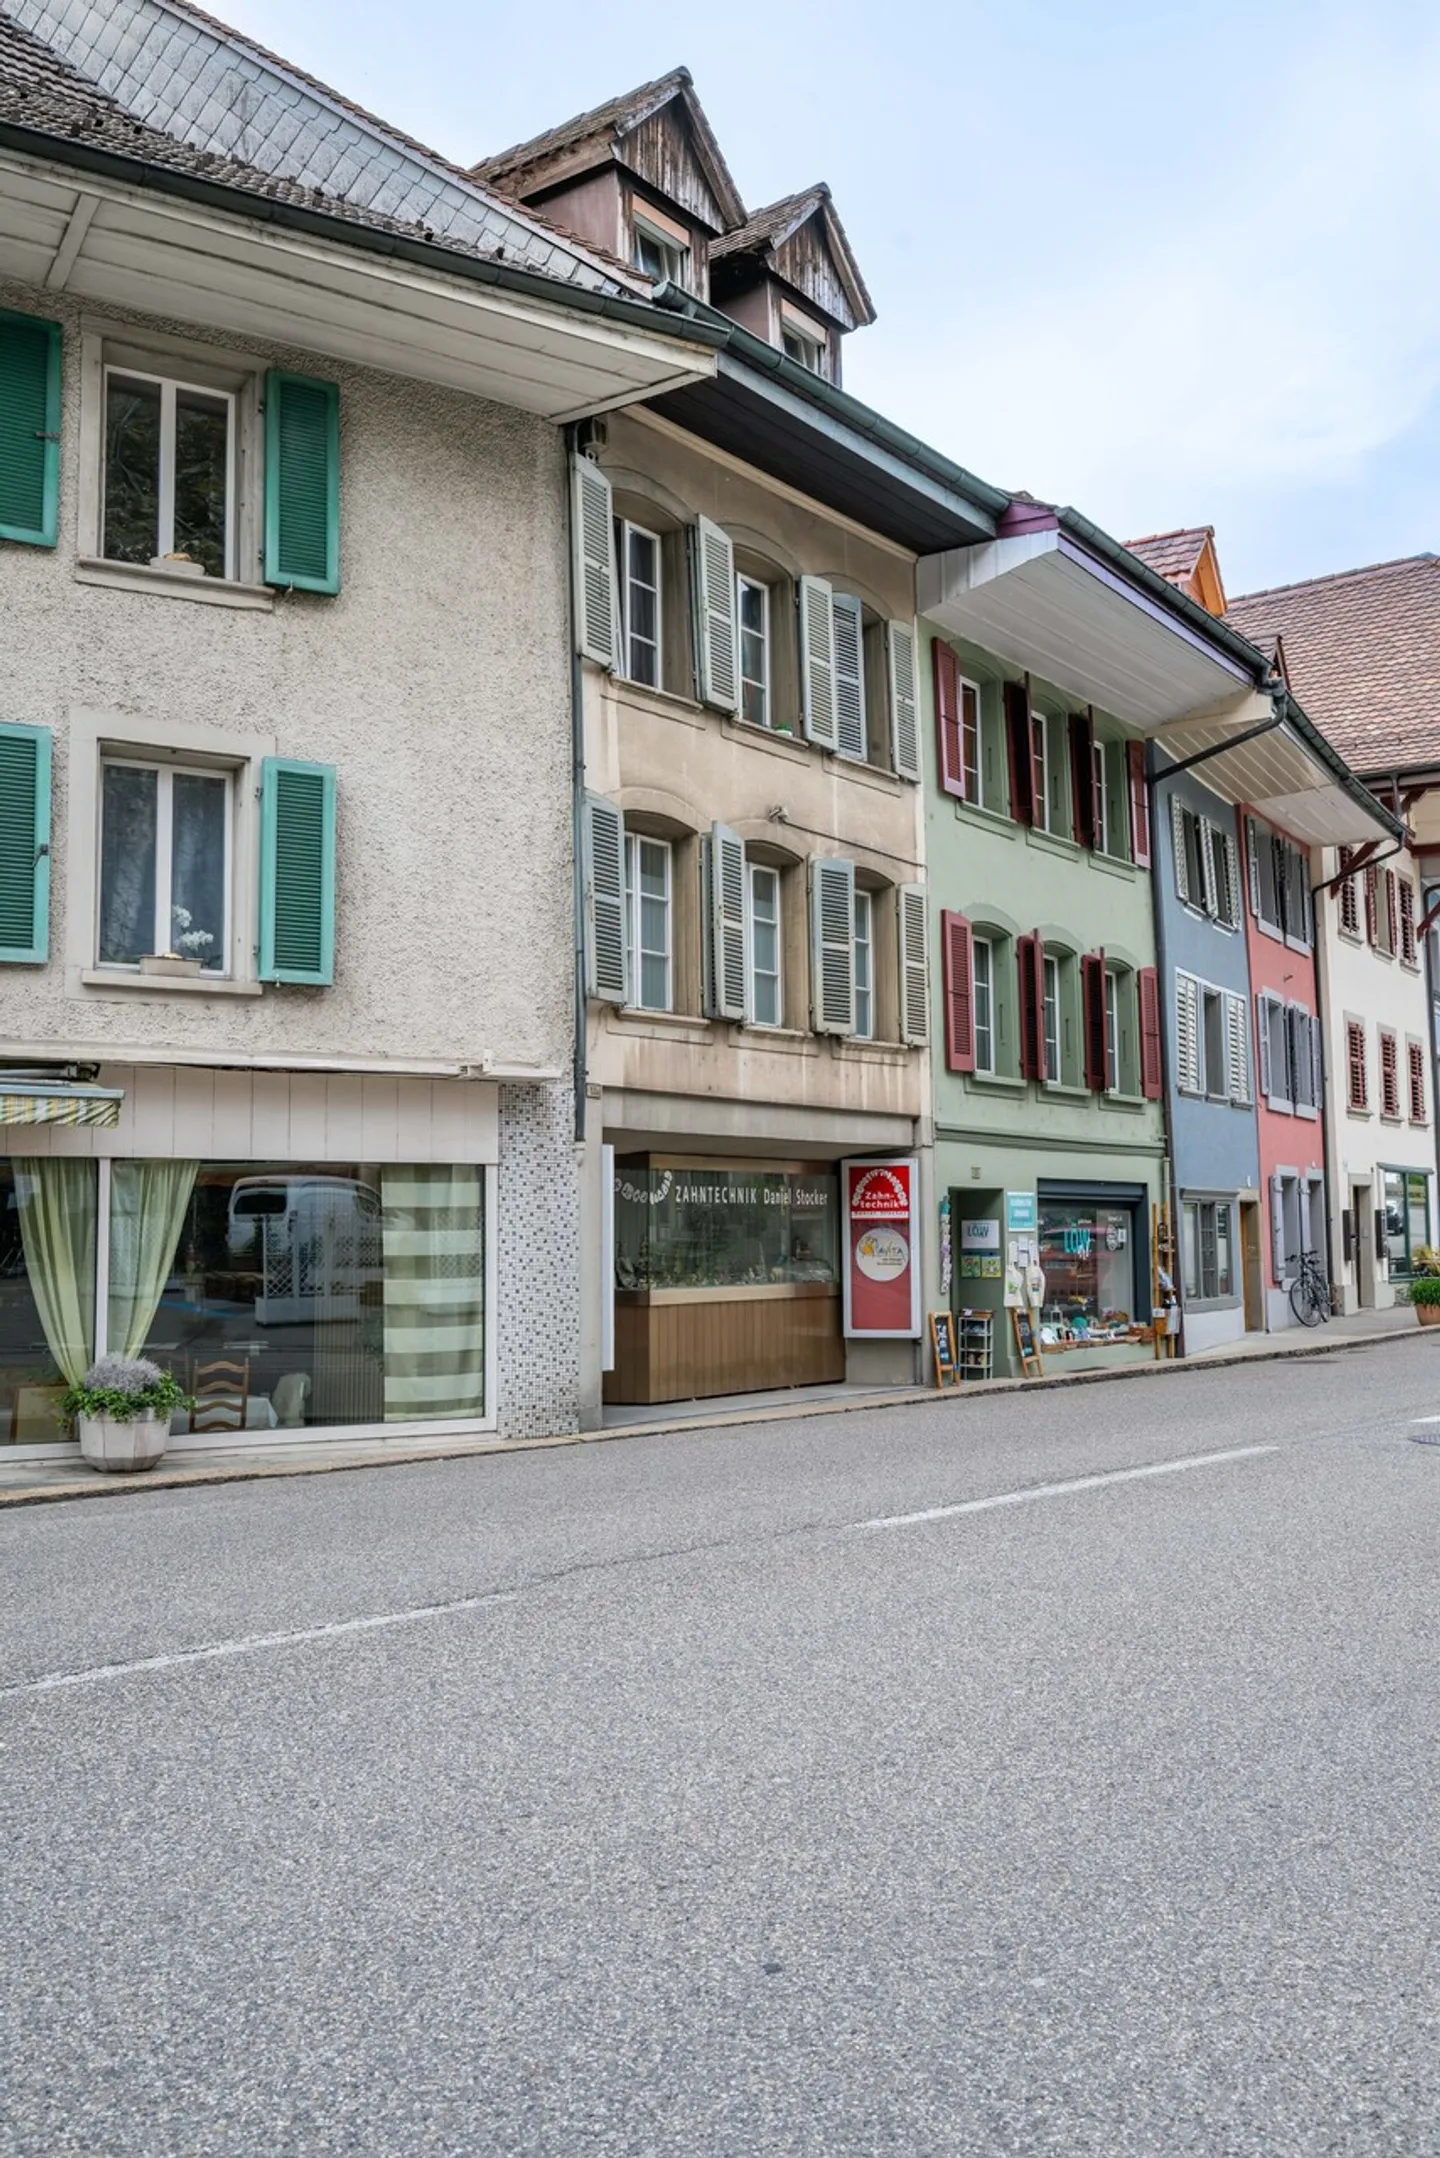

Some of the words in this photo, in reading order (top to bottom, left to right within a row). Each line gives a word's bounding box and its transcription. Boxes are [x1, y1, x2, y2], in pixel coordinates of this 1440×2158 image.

[675, 1185, 757, 1204] ZAHNTECHNIK
[763, 1187, 792, 1205] Daniel
[795, 1188, 828, 1206] Stocker
[860, 1199, 900, 1209] technik
